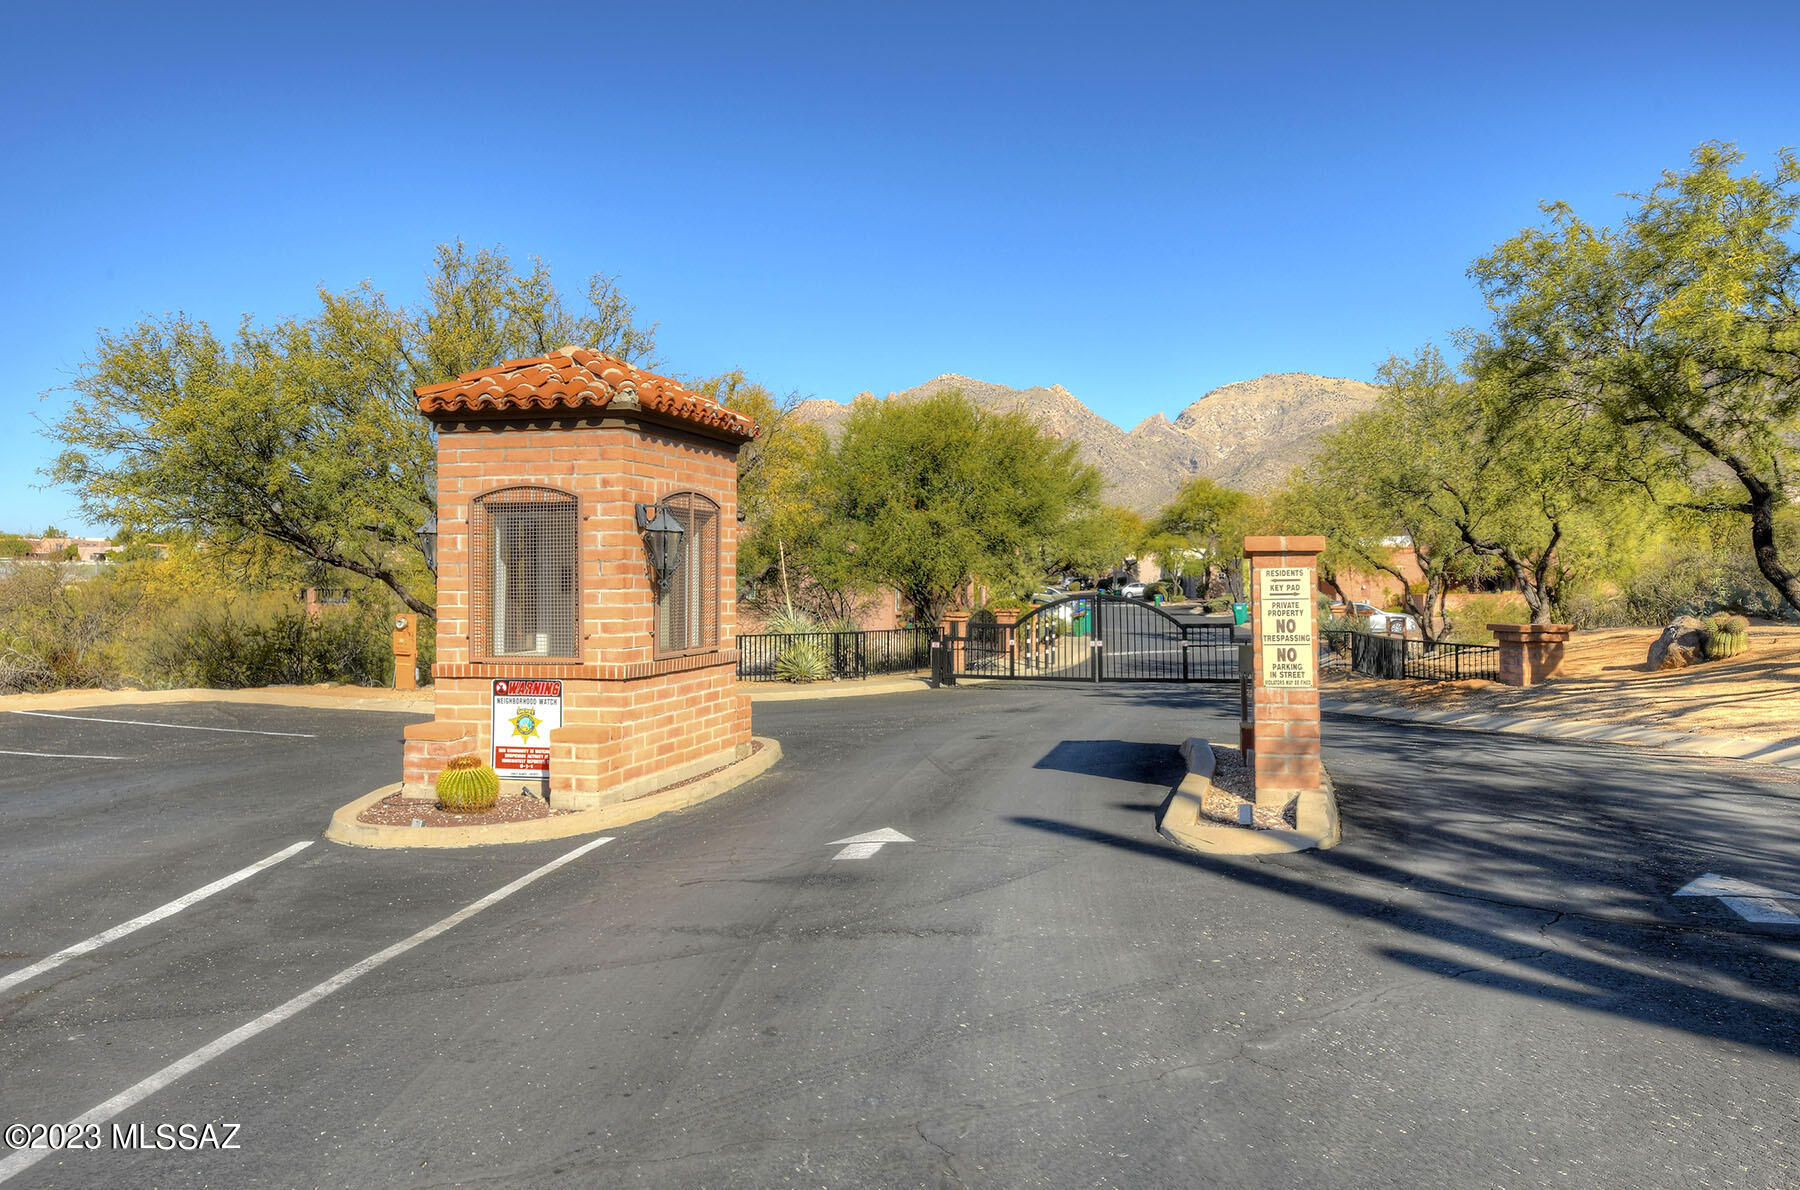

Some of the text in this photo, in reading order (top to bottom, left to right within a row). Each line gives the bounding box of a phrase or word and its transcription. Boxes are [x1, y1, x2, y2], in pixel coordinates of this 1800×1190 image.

[1276, 619, 1296, 633] NO
[1277, 648, 1297, 662] NO
[508, 681, 560, 696] WARNING
